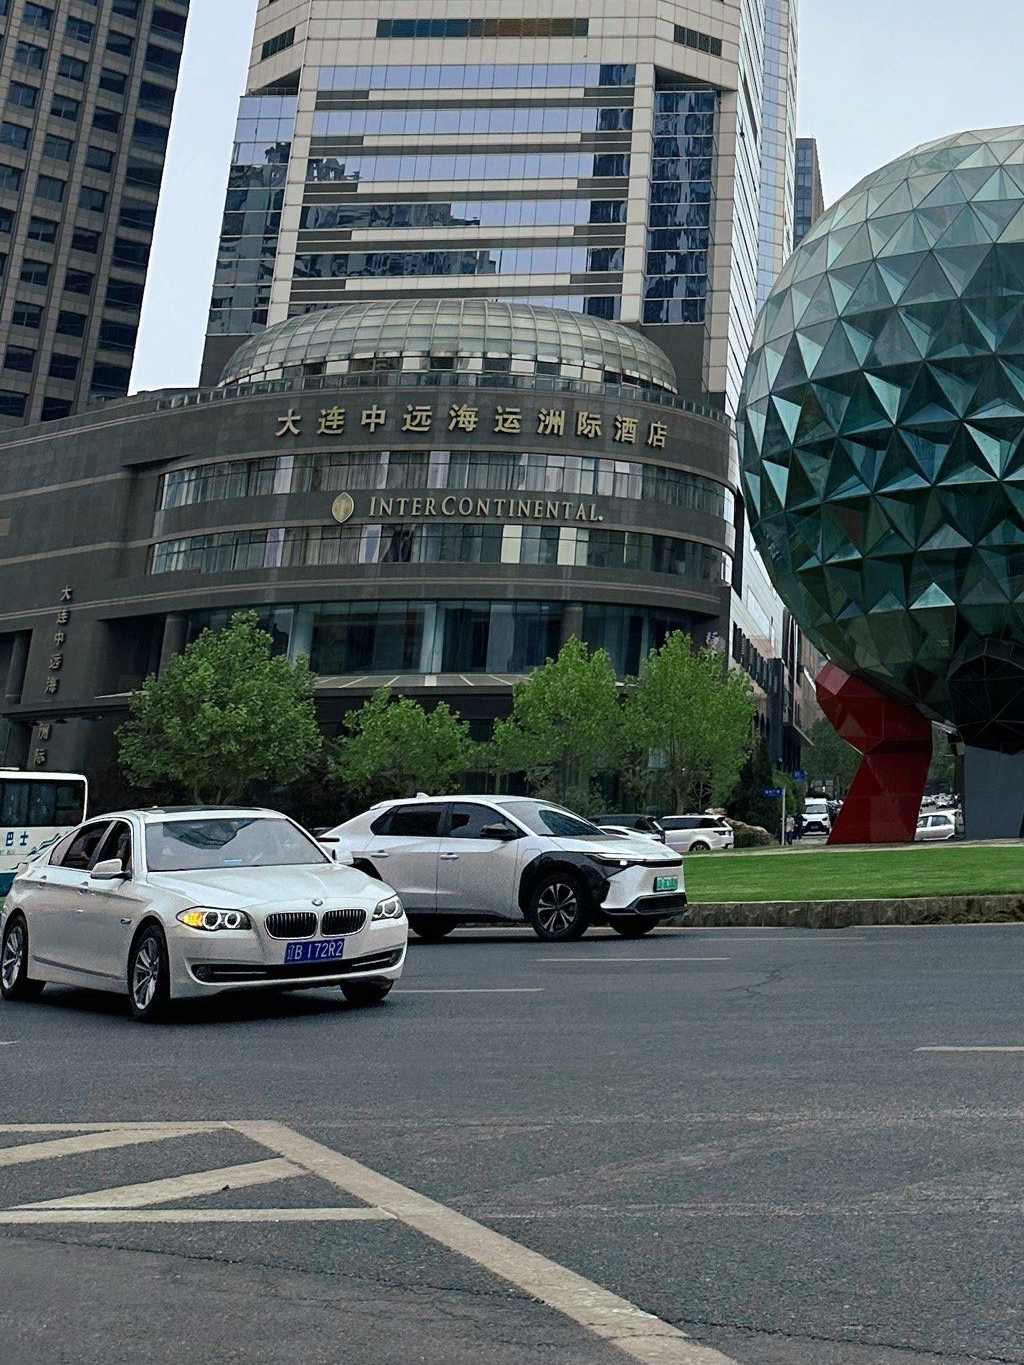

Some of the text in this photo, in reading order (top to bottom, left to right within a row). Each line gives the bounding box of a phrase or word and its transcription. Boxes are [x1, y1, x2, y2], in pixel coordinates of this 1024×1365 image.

[275, 404, 668, 448] 大连中远海运洲际酒店
[369, 496, 601, 521] INTERCONTINENTAL
[5, 831, 29, 846] 巴士
